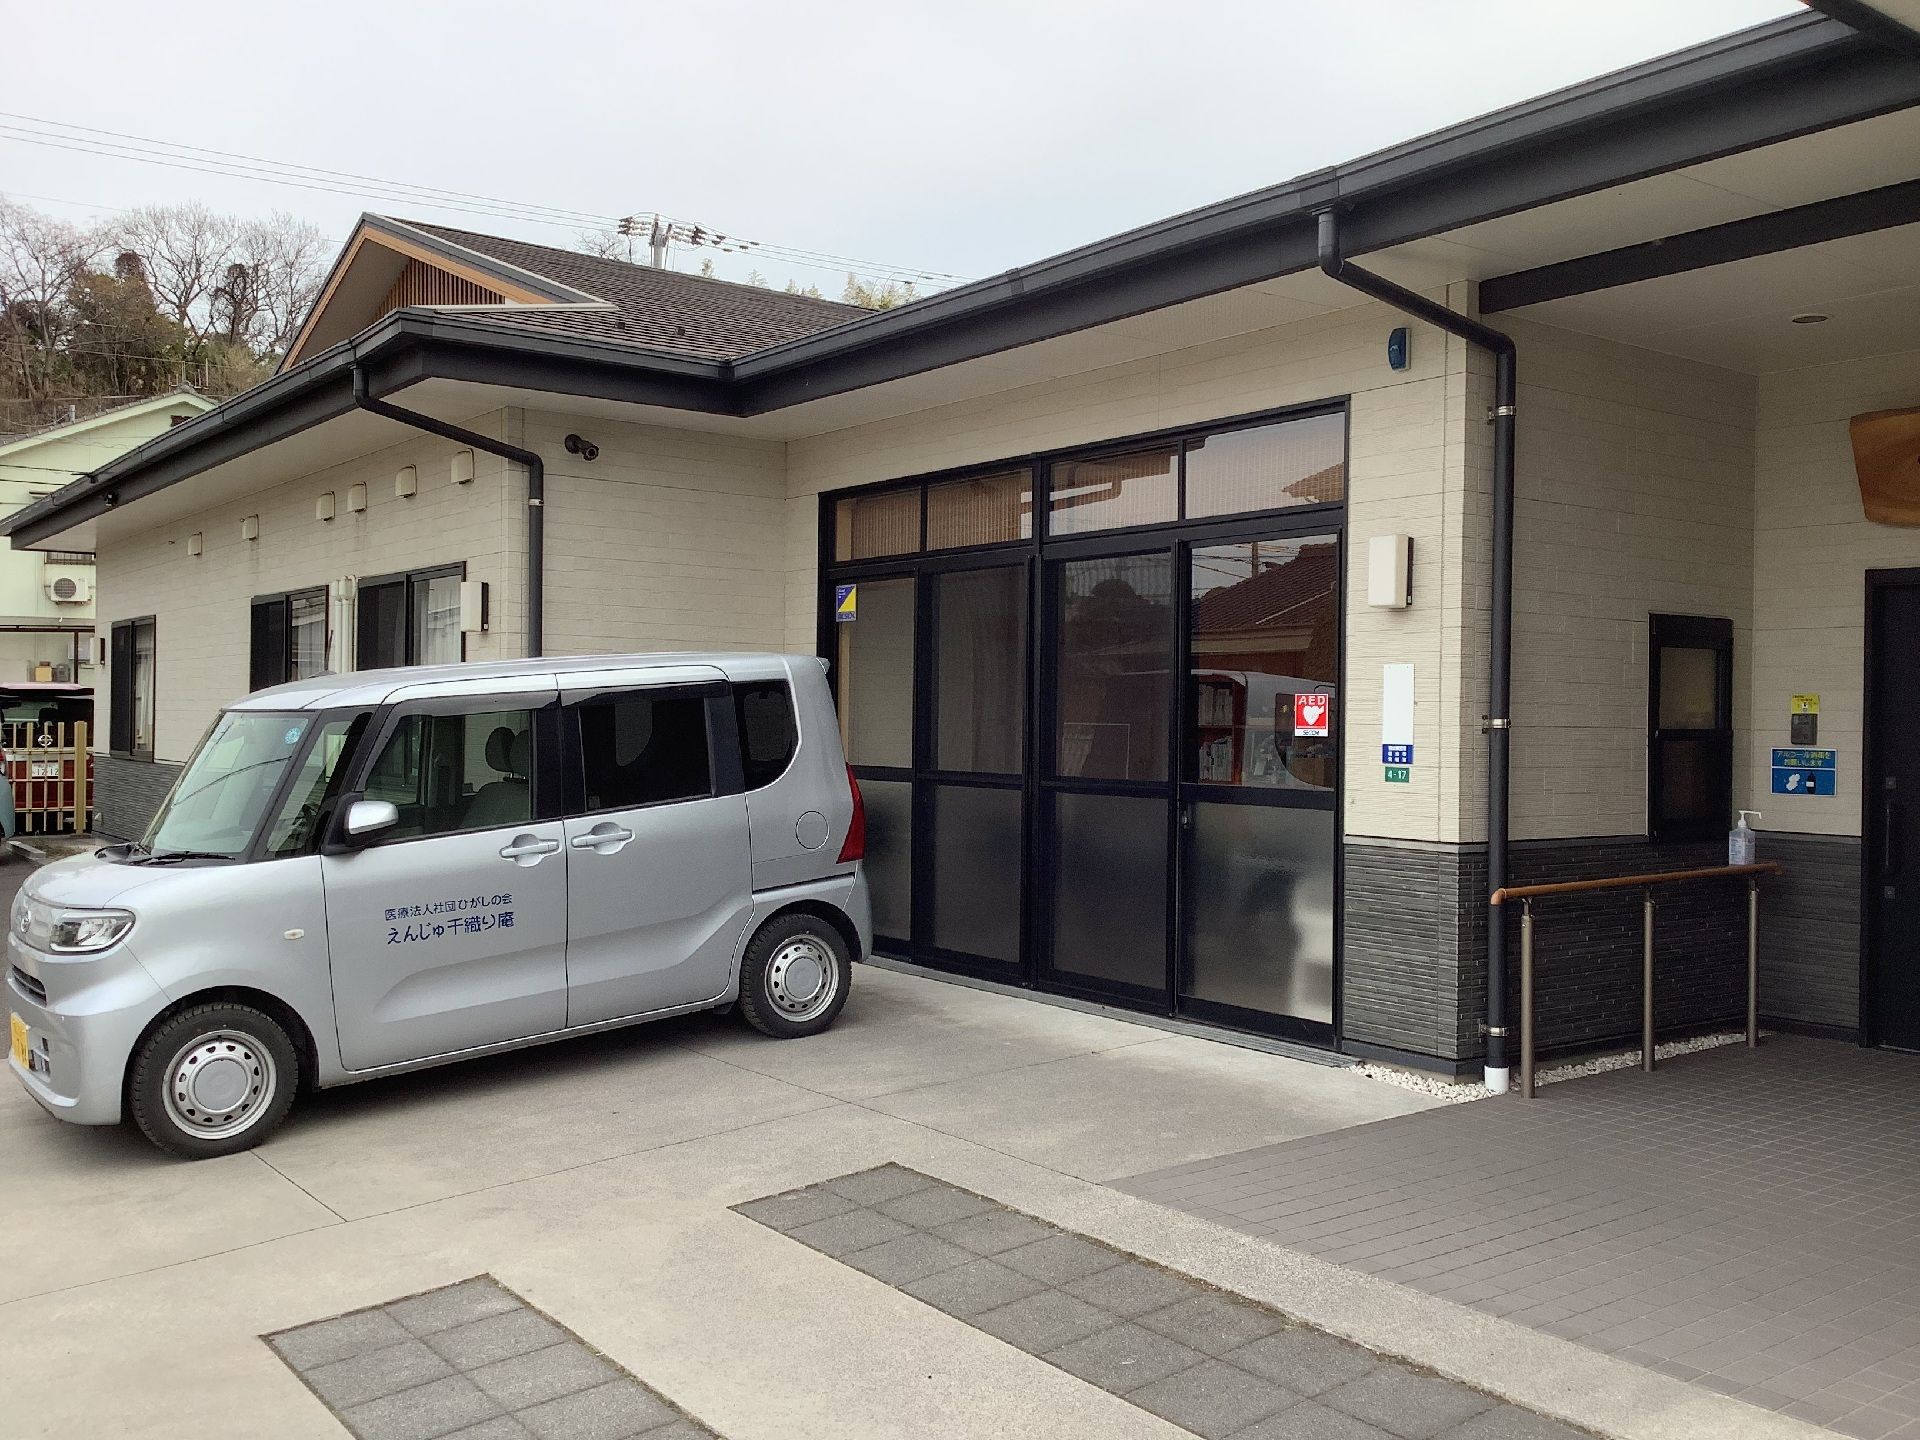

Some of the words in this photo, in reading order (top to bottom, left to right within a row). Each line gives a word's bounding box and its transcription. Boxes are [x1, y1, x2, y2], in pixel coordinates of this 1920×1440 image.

[1298, 695, 1326, 705] AED
[1387, 770, 1407, 780] 4-17
[384, 893, 513, 921] 医療法人社団ひがしの会
